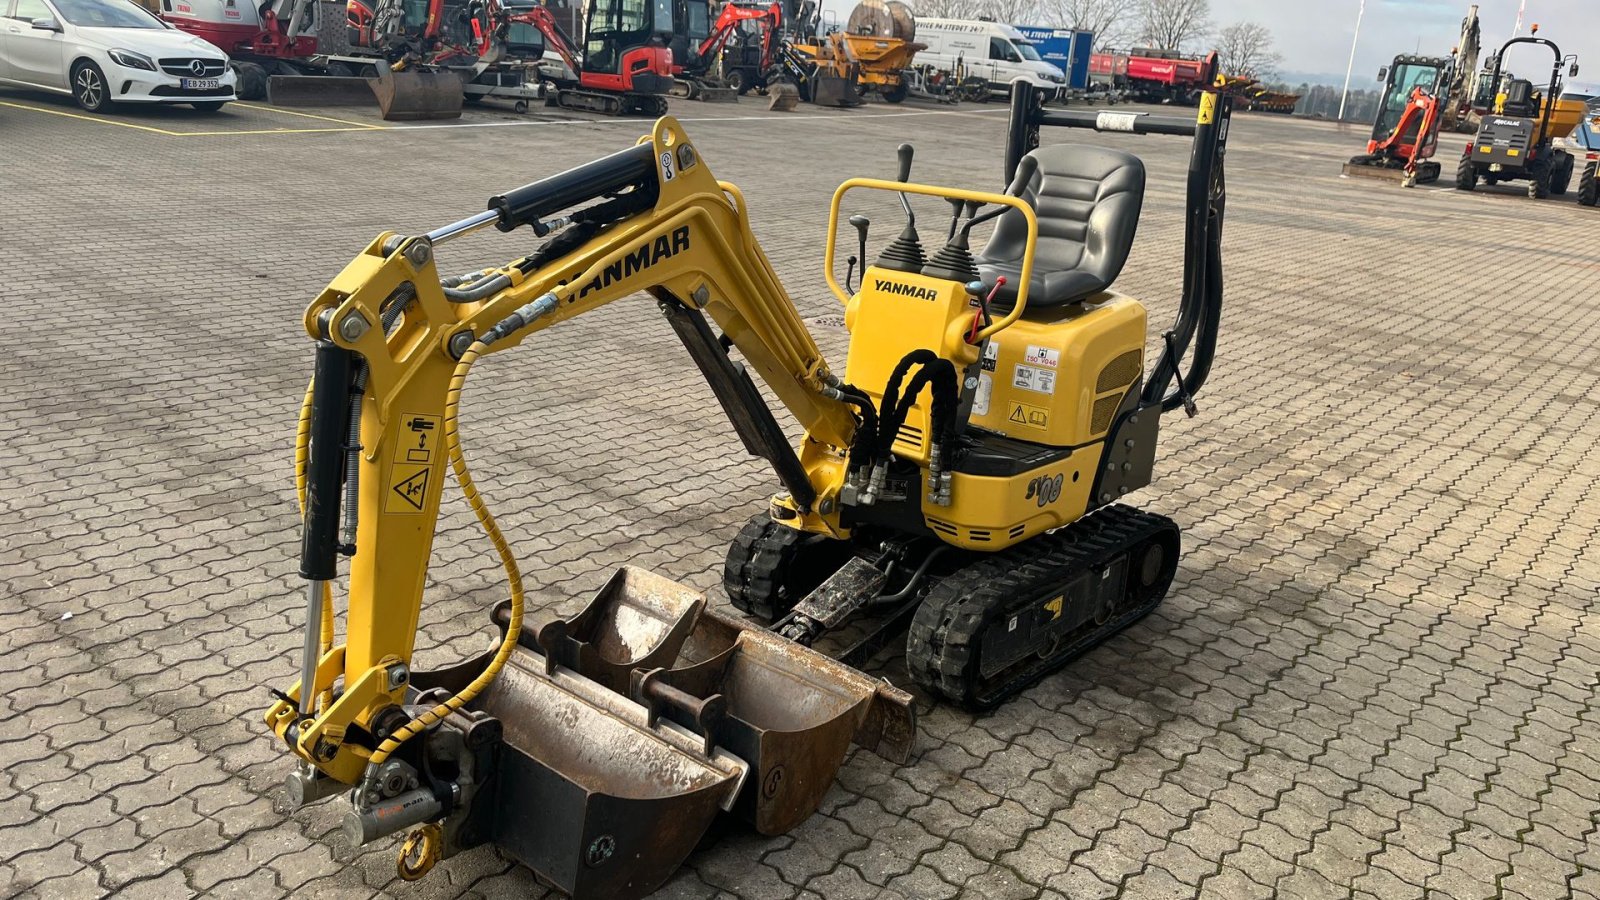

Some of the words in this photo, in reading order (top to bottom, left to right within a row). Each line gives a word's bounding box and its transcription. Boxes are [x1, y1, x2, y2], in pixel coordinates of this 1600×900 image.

[944, 24, 968, 32] STEDET
[188, 80, 198, 88] EB
[199, 80, 206, 88] 29
[207, 80, 218, 88] 352
[557, 225, 690, 303] YANMAR
[875, 280, 938, 301] YANMAR
[1027, 355, 1038, 363] ISO
